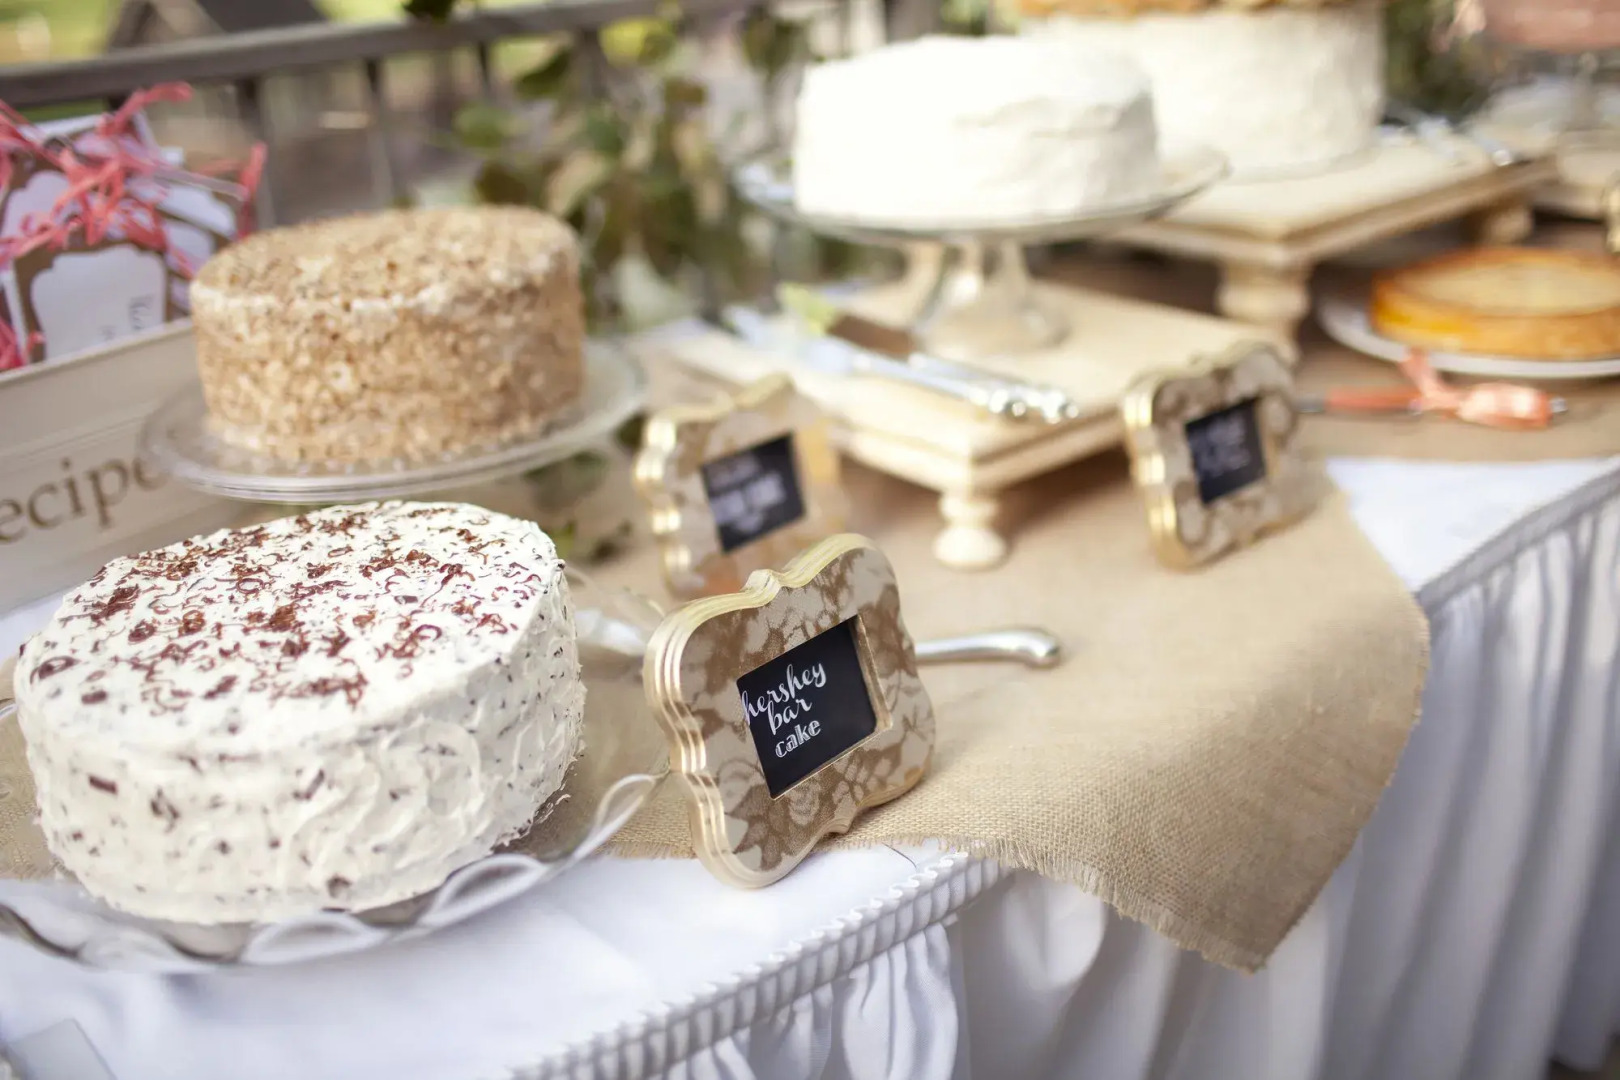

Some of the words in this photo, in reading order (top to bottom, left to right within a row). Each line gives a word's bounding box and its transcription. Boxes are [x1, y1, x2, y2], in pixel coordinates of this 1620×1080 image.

[741, 663, 827, 726] hershey
[767, 699, 813, 736] bar
[775, 720, 821, 758] cake
